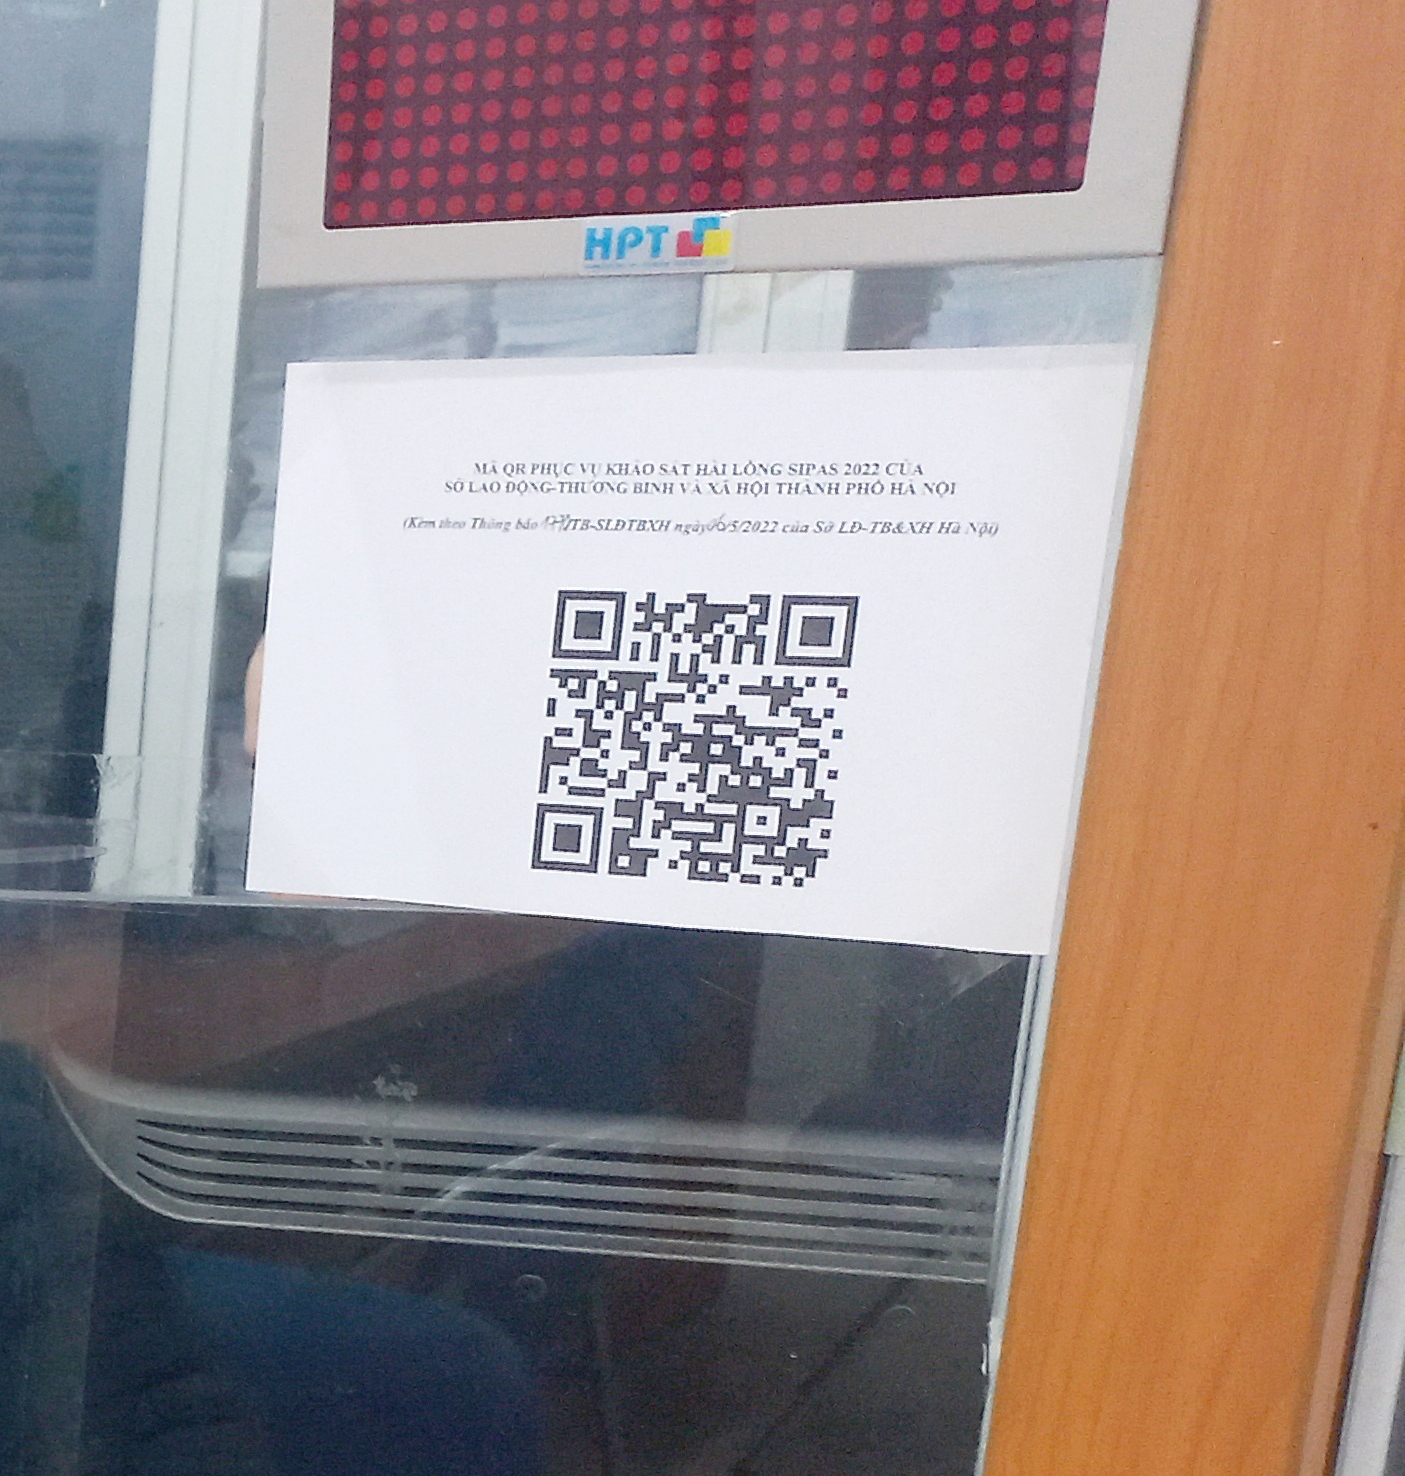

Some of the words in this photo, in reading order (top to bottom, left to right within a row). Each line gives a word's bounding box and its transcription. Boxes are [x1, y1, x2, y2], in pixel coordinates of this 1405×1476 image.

[584, 225, 670, 261] HPT
[787, 462, 839, 477] SIPAS
[843, 462, 880, 477] 2022
